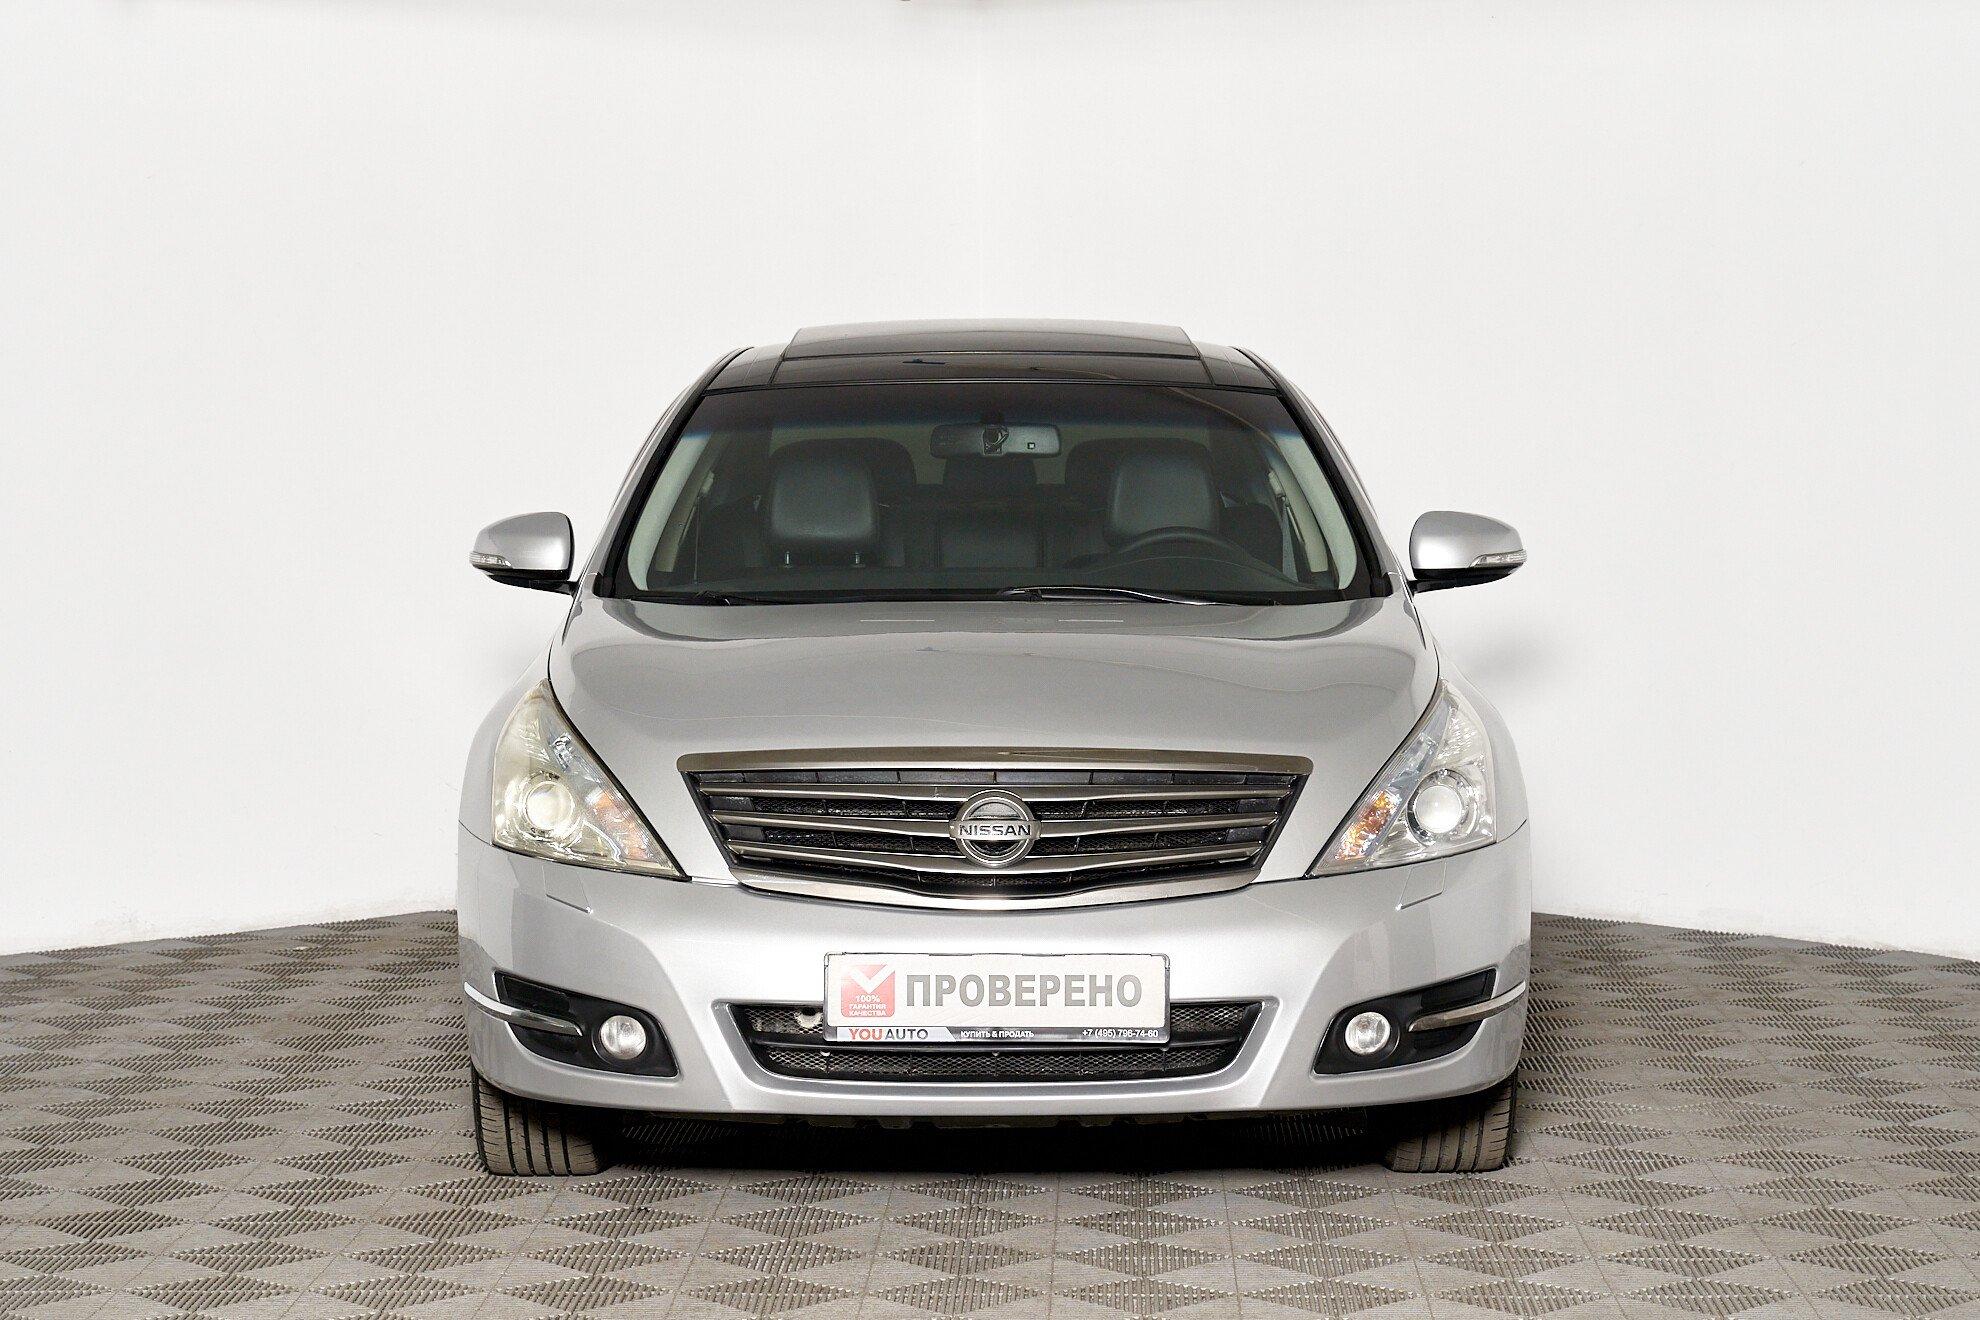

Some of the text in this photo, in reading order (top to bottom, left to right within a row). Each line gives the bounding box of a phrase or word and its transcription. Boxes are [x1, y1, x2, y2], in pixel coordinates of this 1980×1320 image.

[959, 825, 1031, 836] NISSAN
[906, 974, 1142, 1007] ПРОВЕРЕНО
[855, 994, 881, 1002] 100%
[961, 1030, 1034, 1038] КУПИТЬ & ПРОДАТЬ
[1082, 1028, 1159, 1038] +7 (495) 796-74-60
